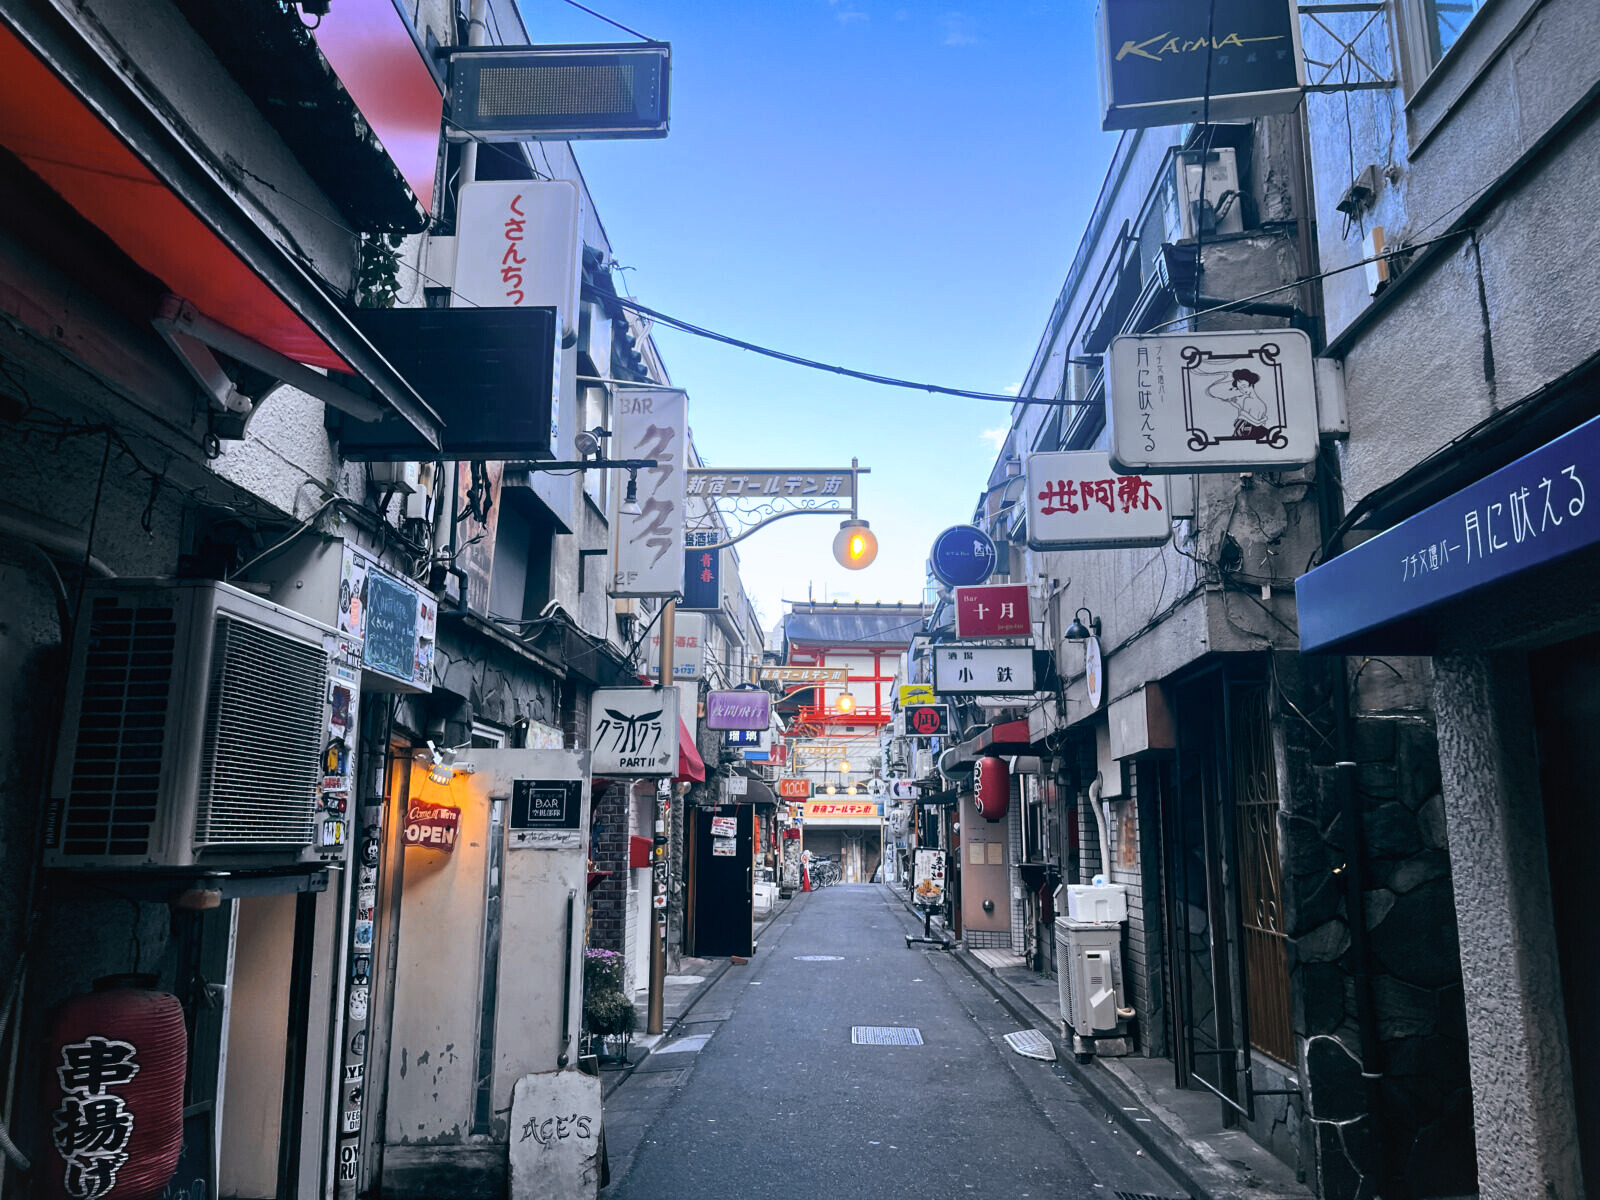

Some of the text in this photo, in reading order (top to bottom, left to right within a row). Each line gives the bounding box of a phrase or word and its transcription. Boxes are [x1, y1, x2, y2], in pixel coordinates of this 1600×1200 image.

[620, 397, 654, 414] BAR
[1136, 347, 1156, 452] 月に吠える
[686, 474, 843, 495] 新宿ゴールデン街
[629, 424, 676, 570] クラクラ
[1465, 465, 1585, 564] 月に吠える
[701, 553, 714, 582] 青春
[1401, 539, 1461, 582] プチ文壇バー
[615, 571, 638, 585] 2F
[972, 602, 1014, 620] 十月
[760, 668, 842, 680] 新宿ゴールデン街
[958, 666, 1013, 682] 小鉄
[620, 758, 646, 767] PART
[785, 782, 806, 795] 10CC
[535, 798, 559, 809] BAR
[812, 805, 872, 813] 新宿ゴールデン街
[406, 824, 454, 844] OPEN
[53, 1036, 140, 1200] 串揚げ
[519, 1113, 592, 1145] ACE'S
